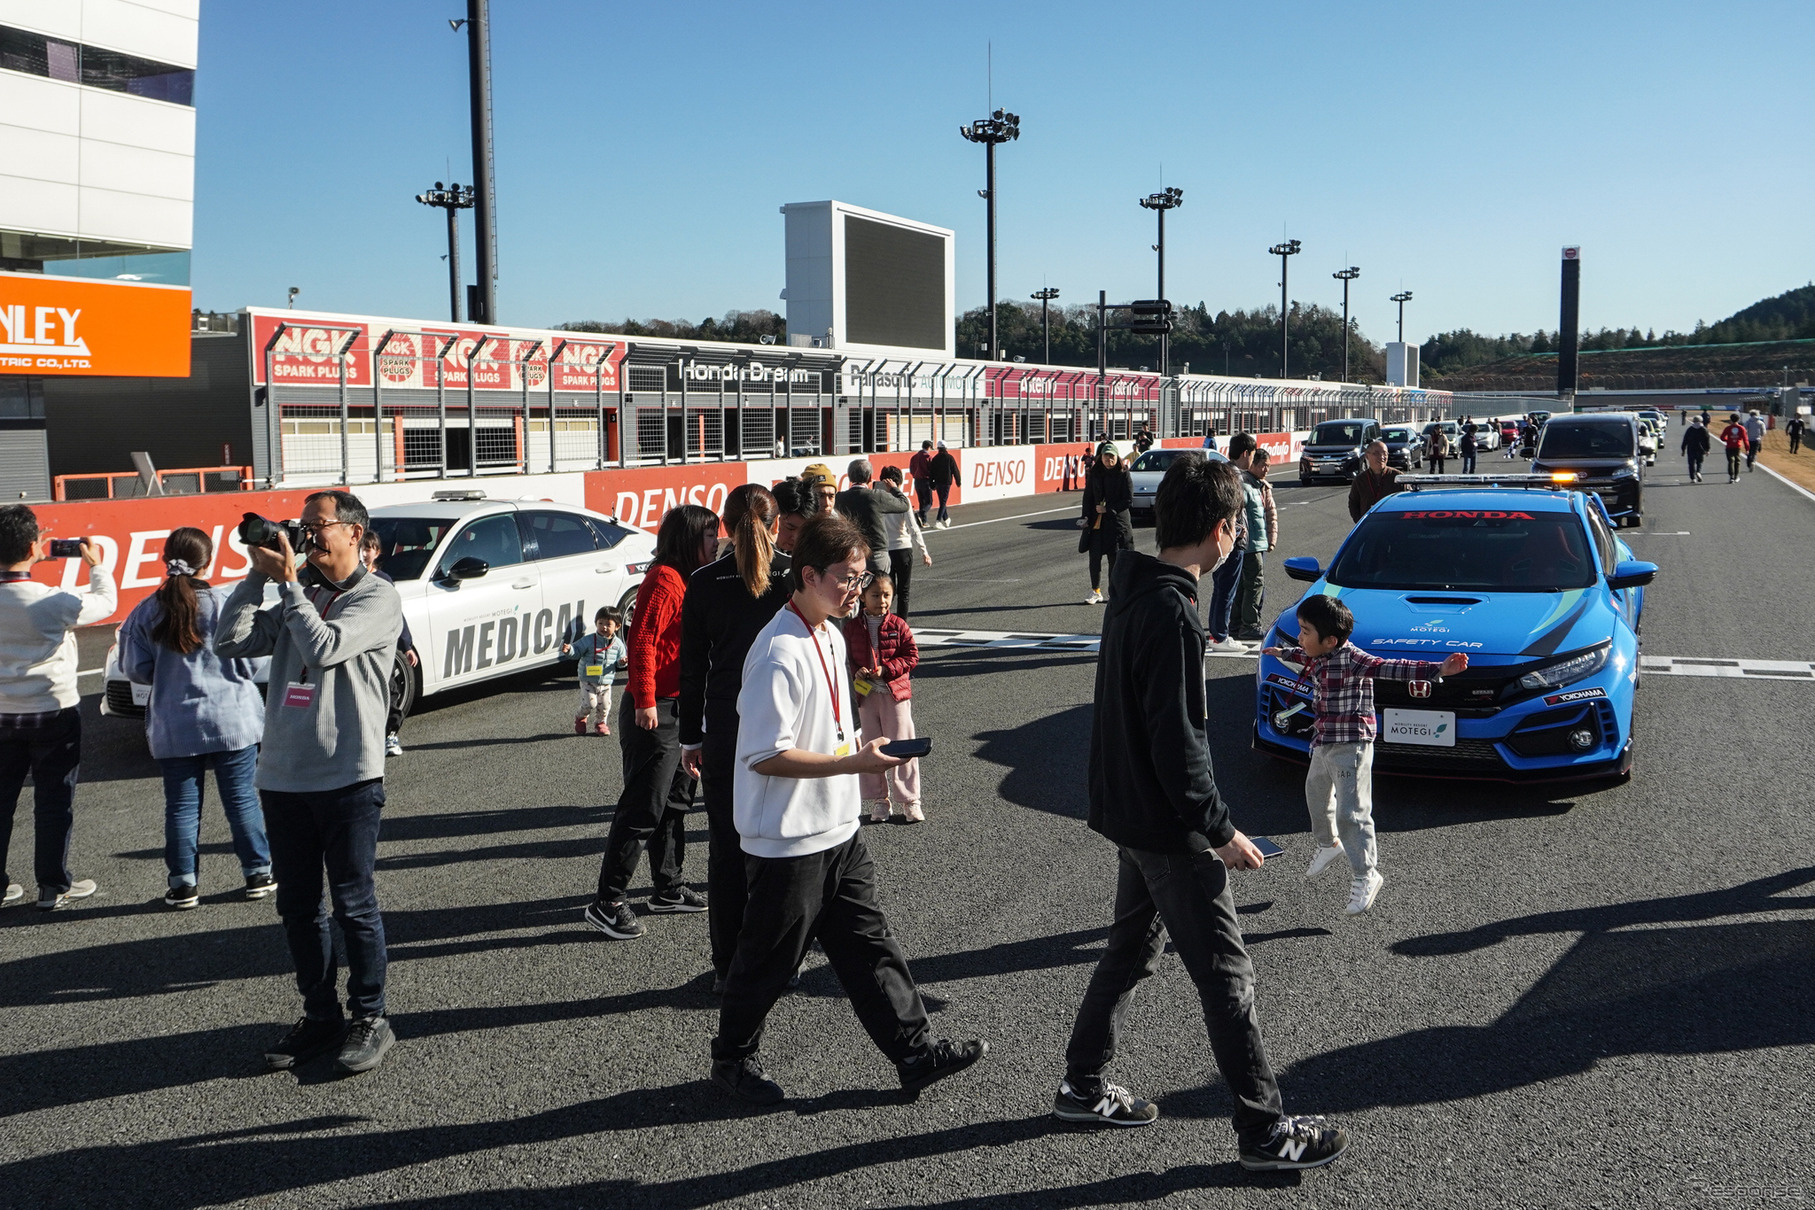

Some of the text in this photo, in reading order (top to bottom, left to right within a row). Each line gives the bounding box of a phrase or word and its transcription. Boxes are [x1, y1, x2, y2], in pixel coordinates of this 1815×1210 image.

[274, 326, 356, 366] NGK
[435, 337, 499, 371] NGK
[563, 344, 615, 375] NGK
[274, 365, 316, 378] SPARK
[383, 367, 411, 375] PLUGS
[678, 358, 809, 383] Honda Dream
[562, 376, 589, 386] SPARK
[973, 459, 1026, 489] DENSO
[1401, 511, 1536, 521] HONDA
[1371, 638, 1484, 649] SAFETY CAR
[1560, 689, 1604, 701] YOKOHAMA
[1390, 727, 1431, 736] MOTEGI
